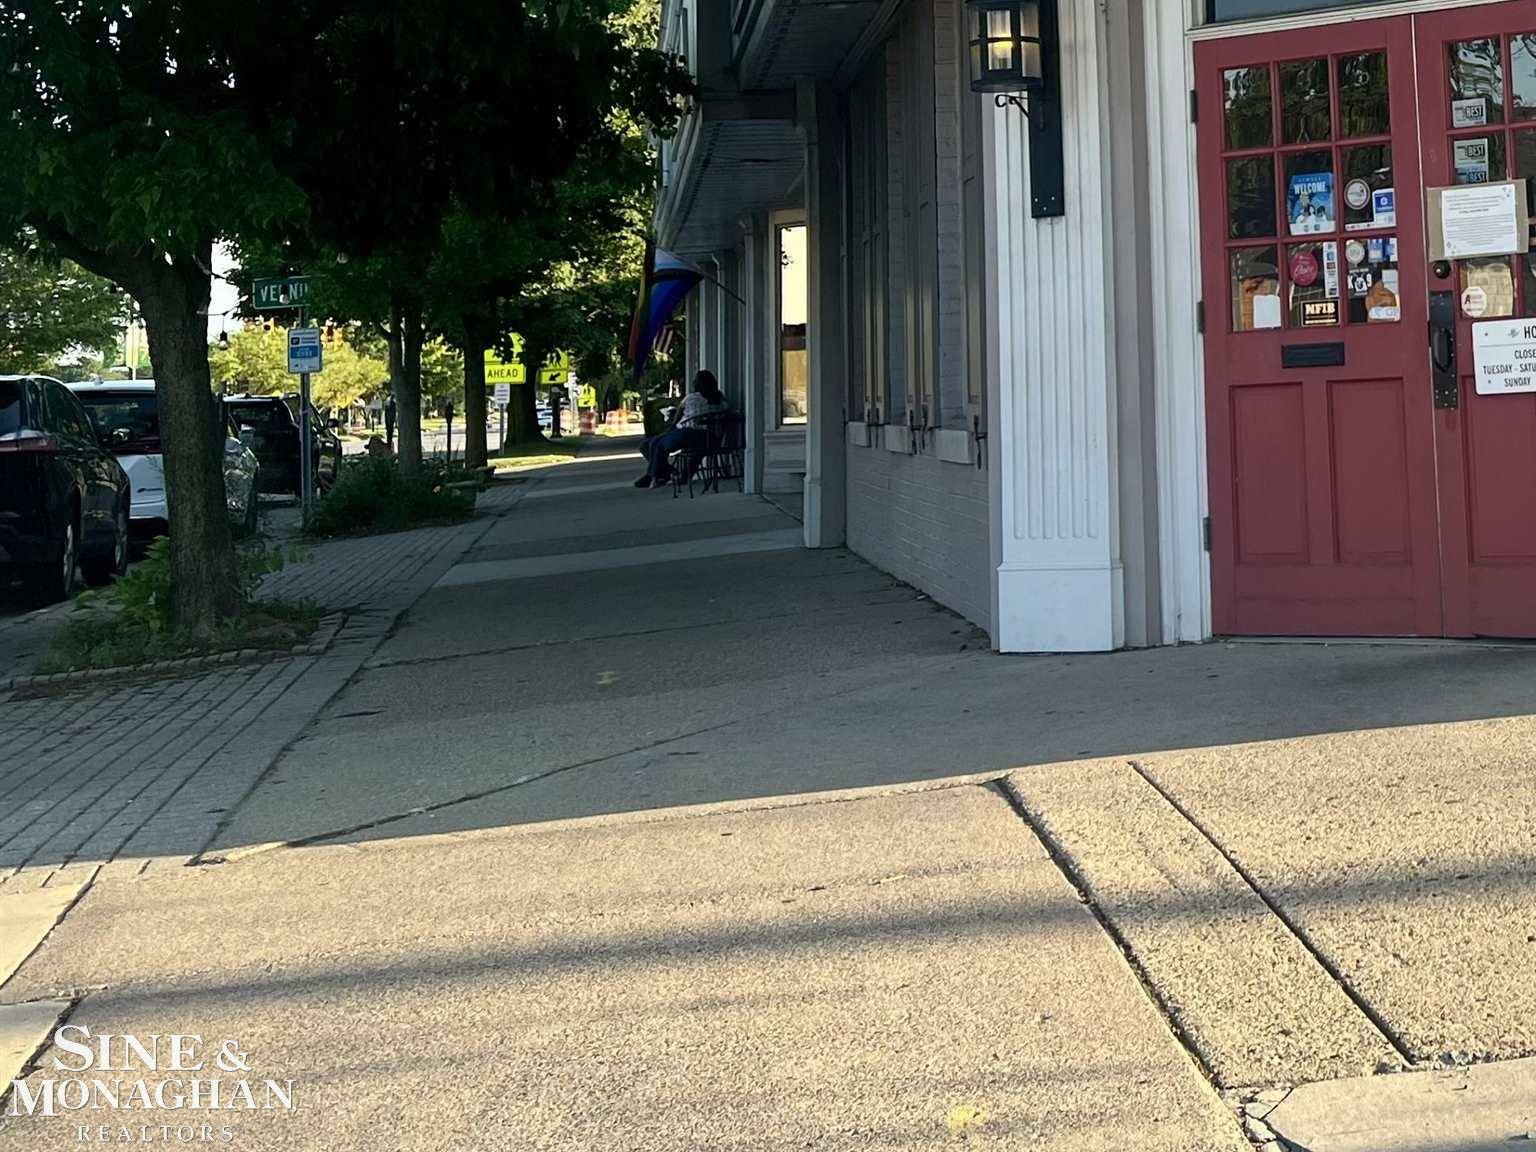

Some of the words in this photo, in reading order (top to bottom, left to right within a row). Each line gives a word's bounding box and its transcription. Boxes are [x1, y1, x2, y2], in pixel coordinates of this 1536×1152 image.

[1293, 181, 1328, 195] WELCOME
[1304, 302, 1336, 315] NFIB
[487, 368, 519, 379] AHEAD
[1483, 363, 1513, 375] TUESDAY
[1503, 377, 1531, 388] SUNDAY
